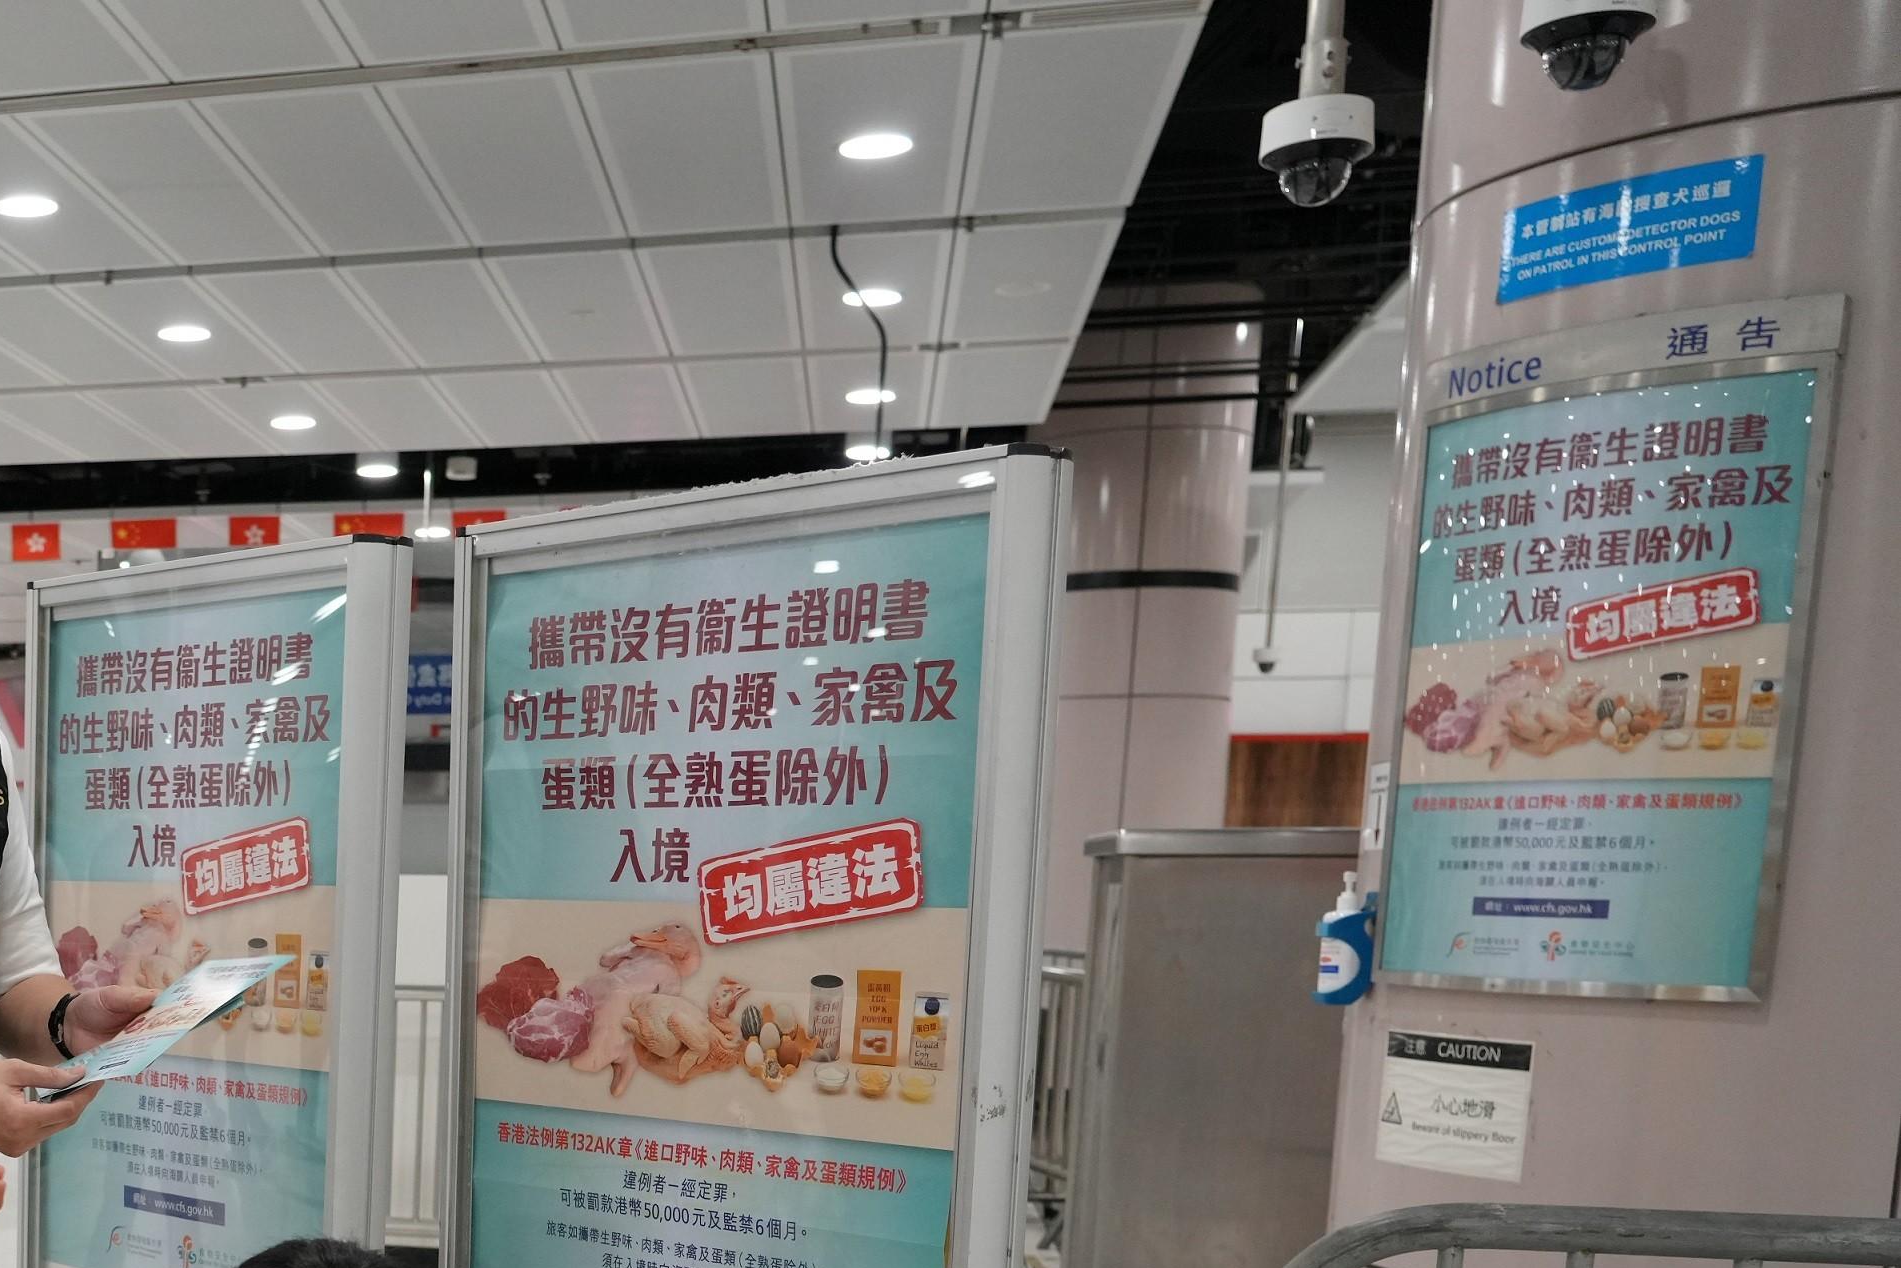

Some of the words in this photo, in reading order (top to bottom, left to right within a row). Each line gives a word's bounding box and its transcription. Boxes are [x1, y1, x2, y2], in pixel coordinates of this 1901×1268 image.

[1510, 251, 1543, 268] THERE
[1544, 244, 1566, 259] ARE
[1629, 218, 1697, 240] DETECTOR
[1700, 210, 1741, 226] DOGS
[1517, 268, 1533, 281] ON
[1533, 258, 1576, 278] PATROL
[1577, 256, 1589, 266] IN
[1591, 249, 1619, 263] THIS
[1684, 229, 1726, 246] POINT
[1666, 316, 1781, 359] 通告
[1448, 354, 1543, 399] Notice
[1498, 586, 1562, 627] 入境
[127, 824, 176, 868] 入境
[196, 836, 300, 898] 均屬違法
[610, 828, 691, 884] 入境
[722, 843, 900, 924] 均屬違法
[1437, 1042, 1501, 1062] CAUTION
[154, 1198, 214, 1217] www.cfs.gov.hk
